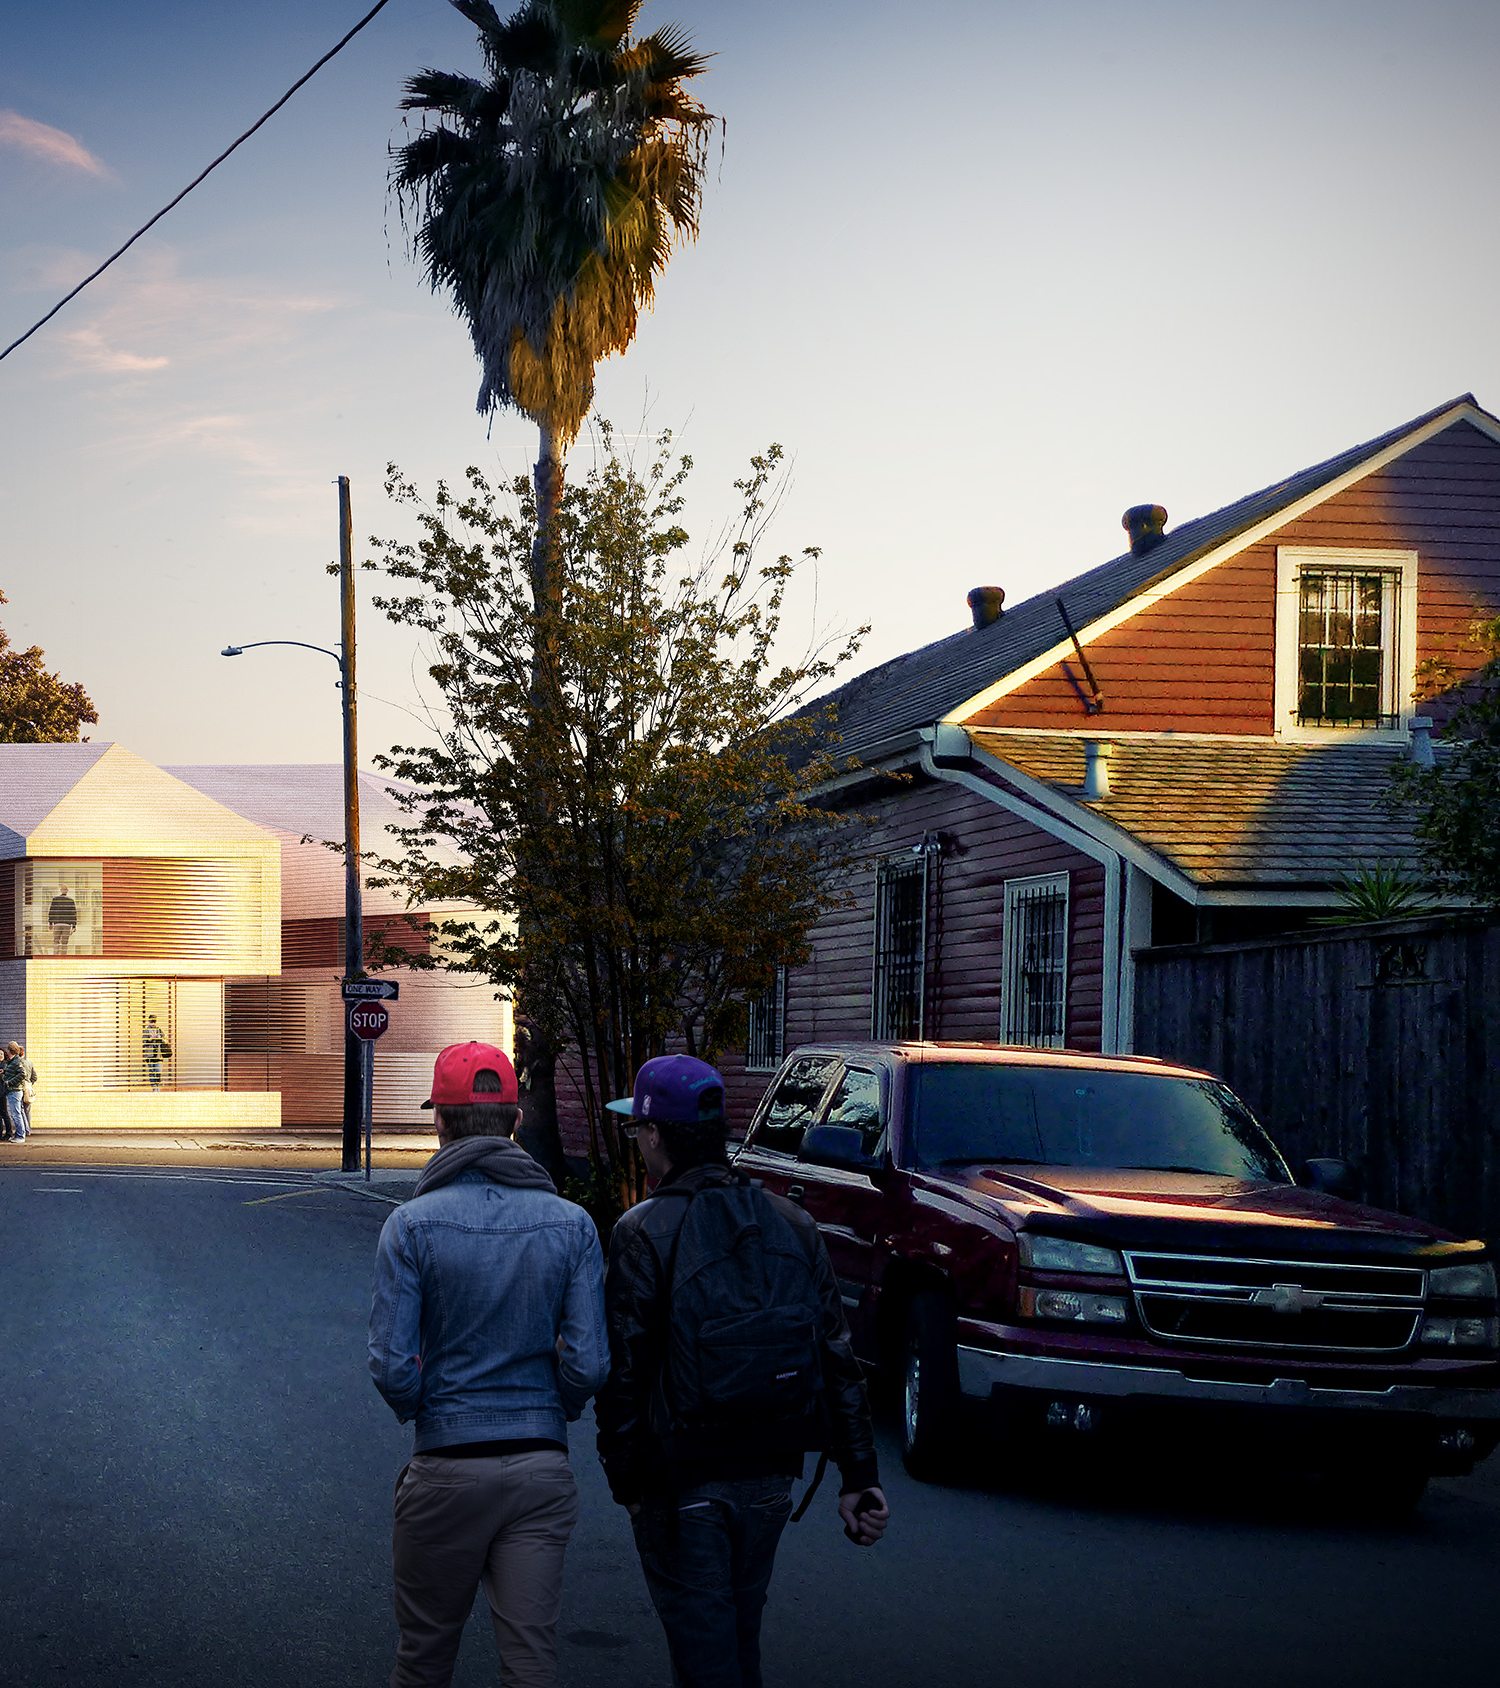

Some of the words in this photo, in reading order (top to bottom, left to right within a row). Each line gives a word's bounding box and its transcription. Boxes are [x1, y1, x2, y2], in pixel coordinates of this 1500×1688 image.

[347, 985, 363, 993] ONE
[366, 985, 382, 993] WAY
[353, 1013, 387, 1028] STOP
